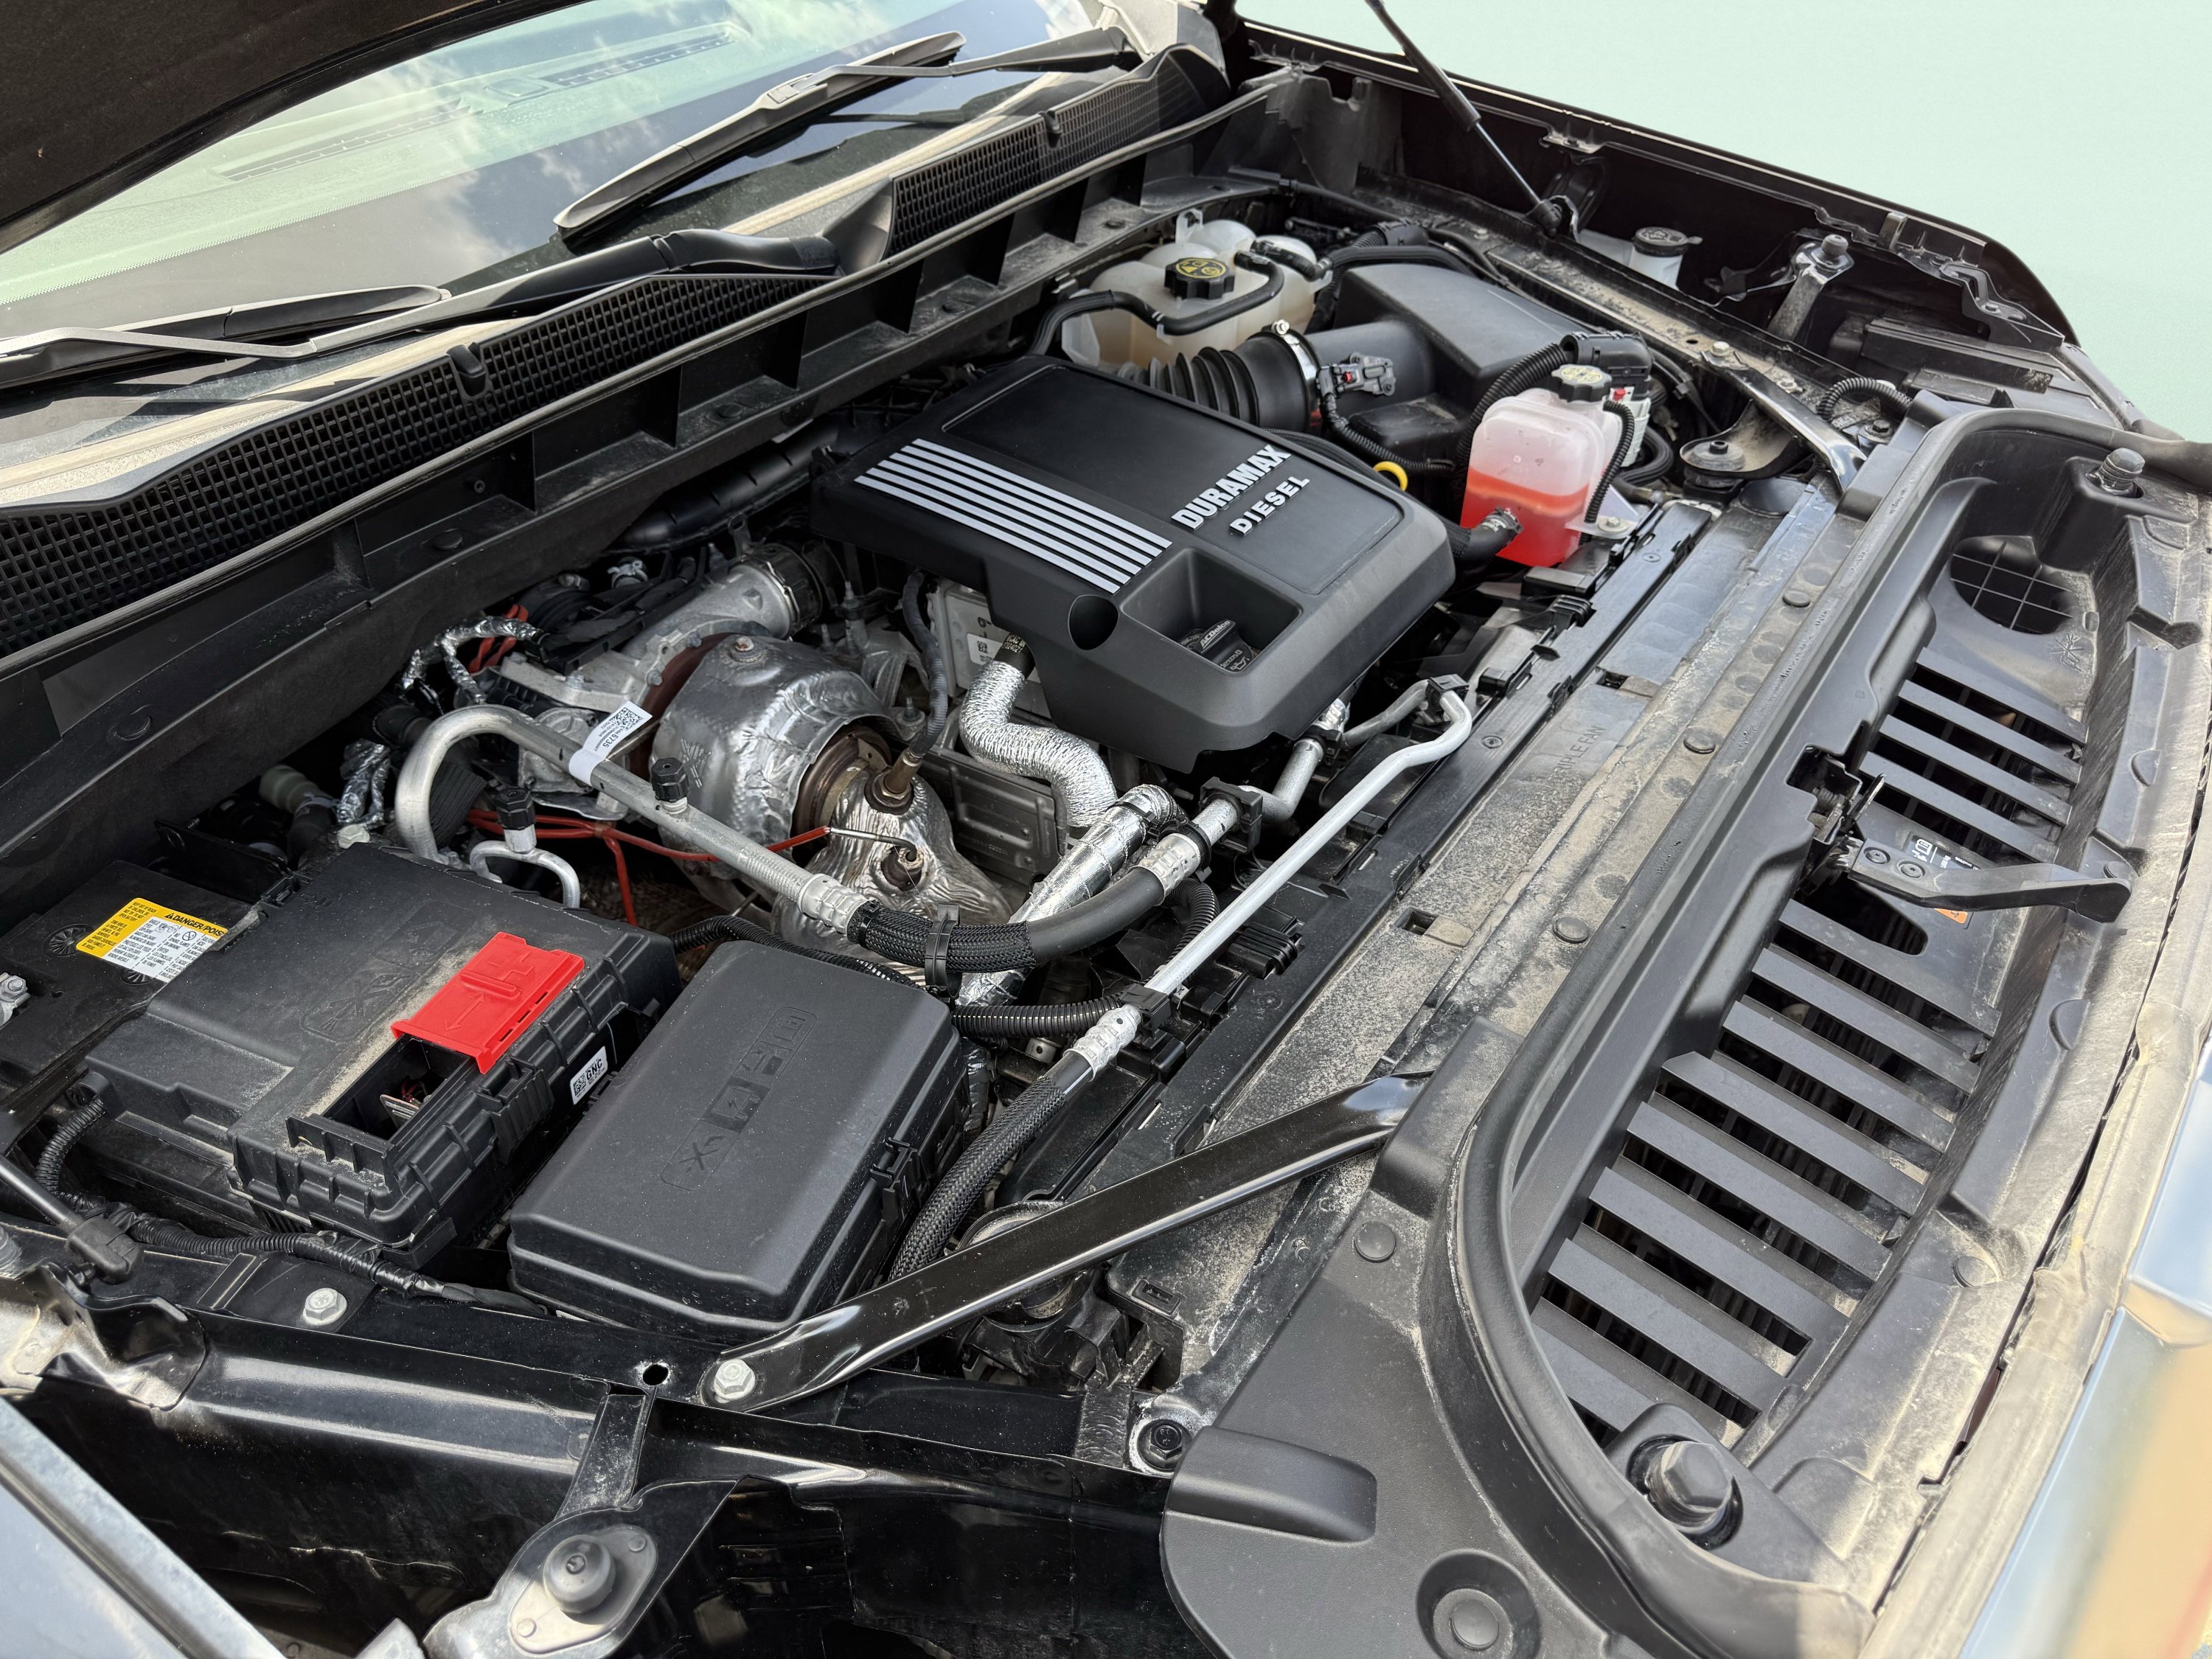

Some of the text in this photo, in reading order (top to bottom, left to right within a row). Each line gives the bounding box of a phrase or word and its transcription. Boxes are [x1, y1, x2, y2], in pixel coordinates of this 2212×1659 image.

[1171, 444, 1292, 530] DURAMAX
[1230, 476, 1310, 536] DIESEL
[1200, 620, 1231, 647] ACDelco
[602, 734, 619, 748] 6735
[1577, 726, 1607, 745] FAN
[586, 1058, 602, 1080] GNC
